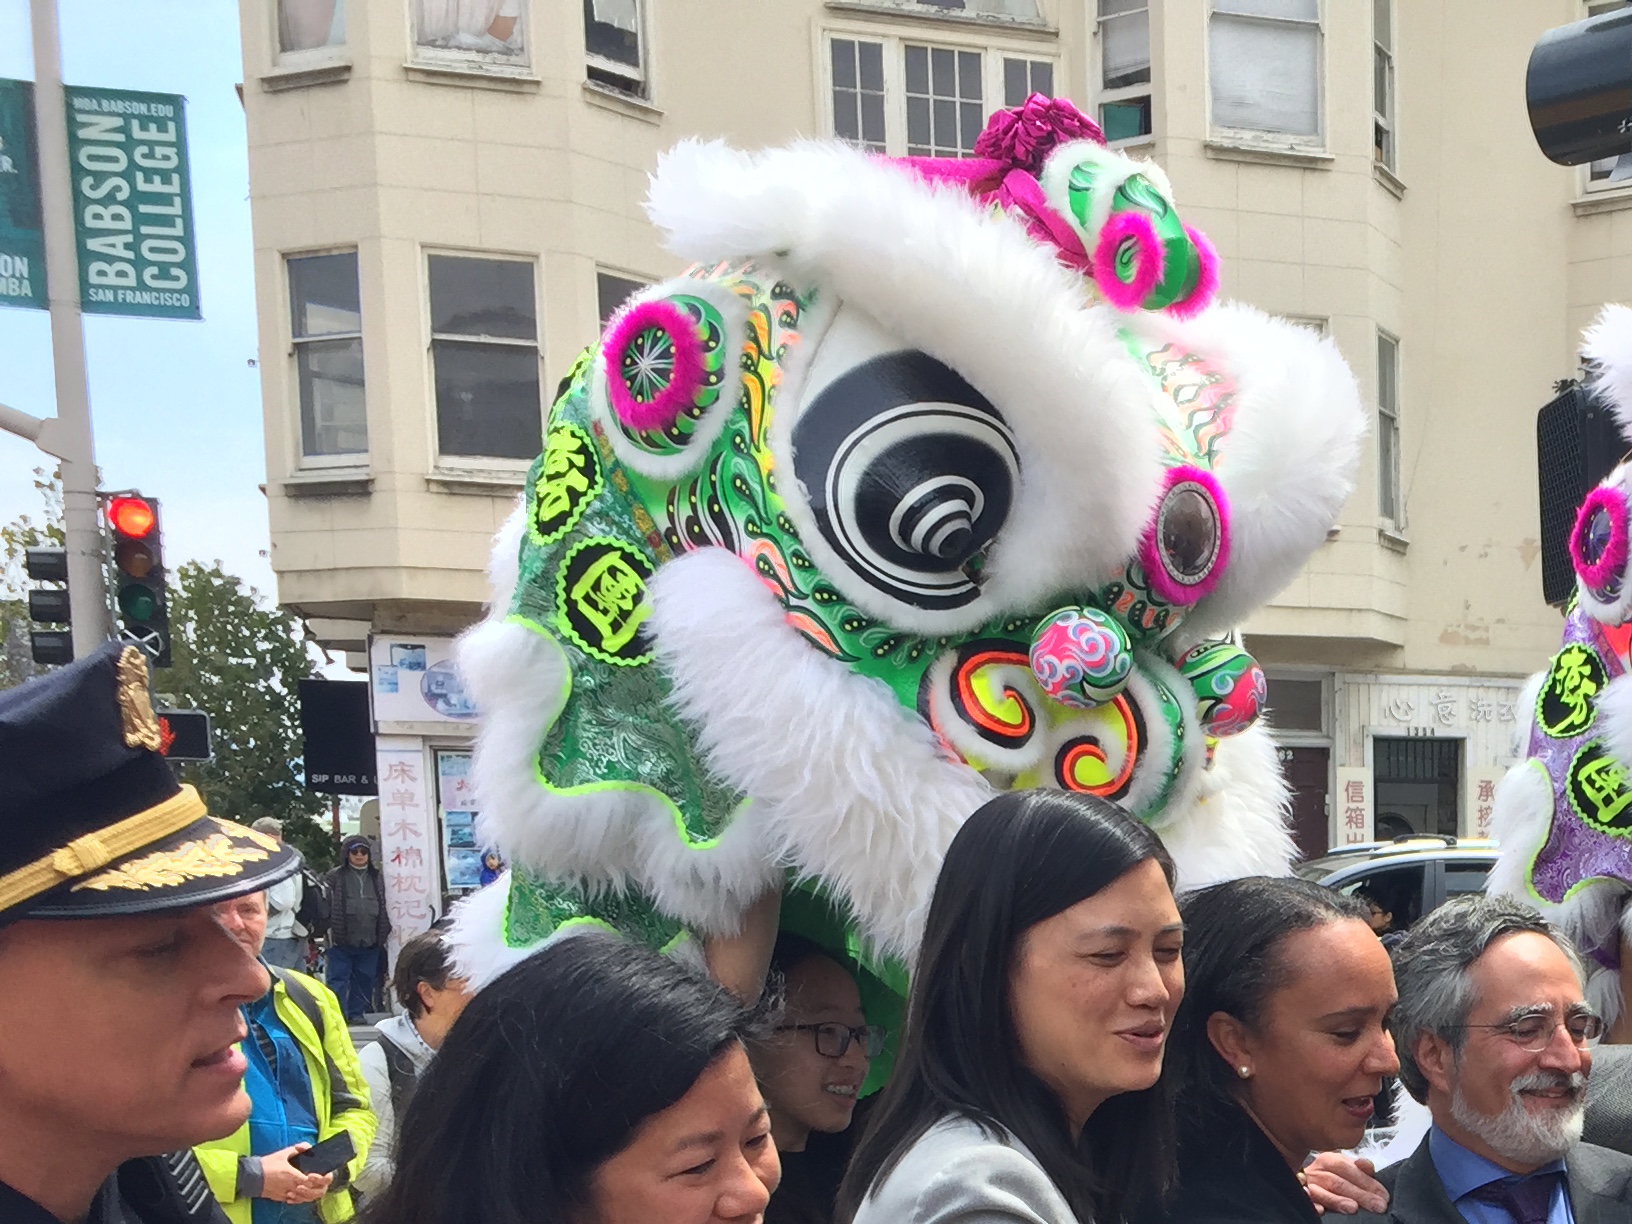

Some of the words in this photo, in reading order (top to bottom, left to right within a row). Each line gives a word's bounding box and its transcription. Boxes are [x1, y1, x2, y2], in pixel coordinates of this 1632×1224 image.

[72, 97, 174, 118] MBA.BABSON.EDU
[76, 112, 138, 288] BABSON
[130, 118, 189, 290] COLLEGE
[88, 287, 115, 303] SAN
[117, 289, 191, 308] FRANCISCO
[311, 773, 330, 784] SIP
[333, 774, 357, 785] BAR
[360, 775, 369, 785] &
